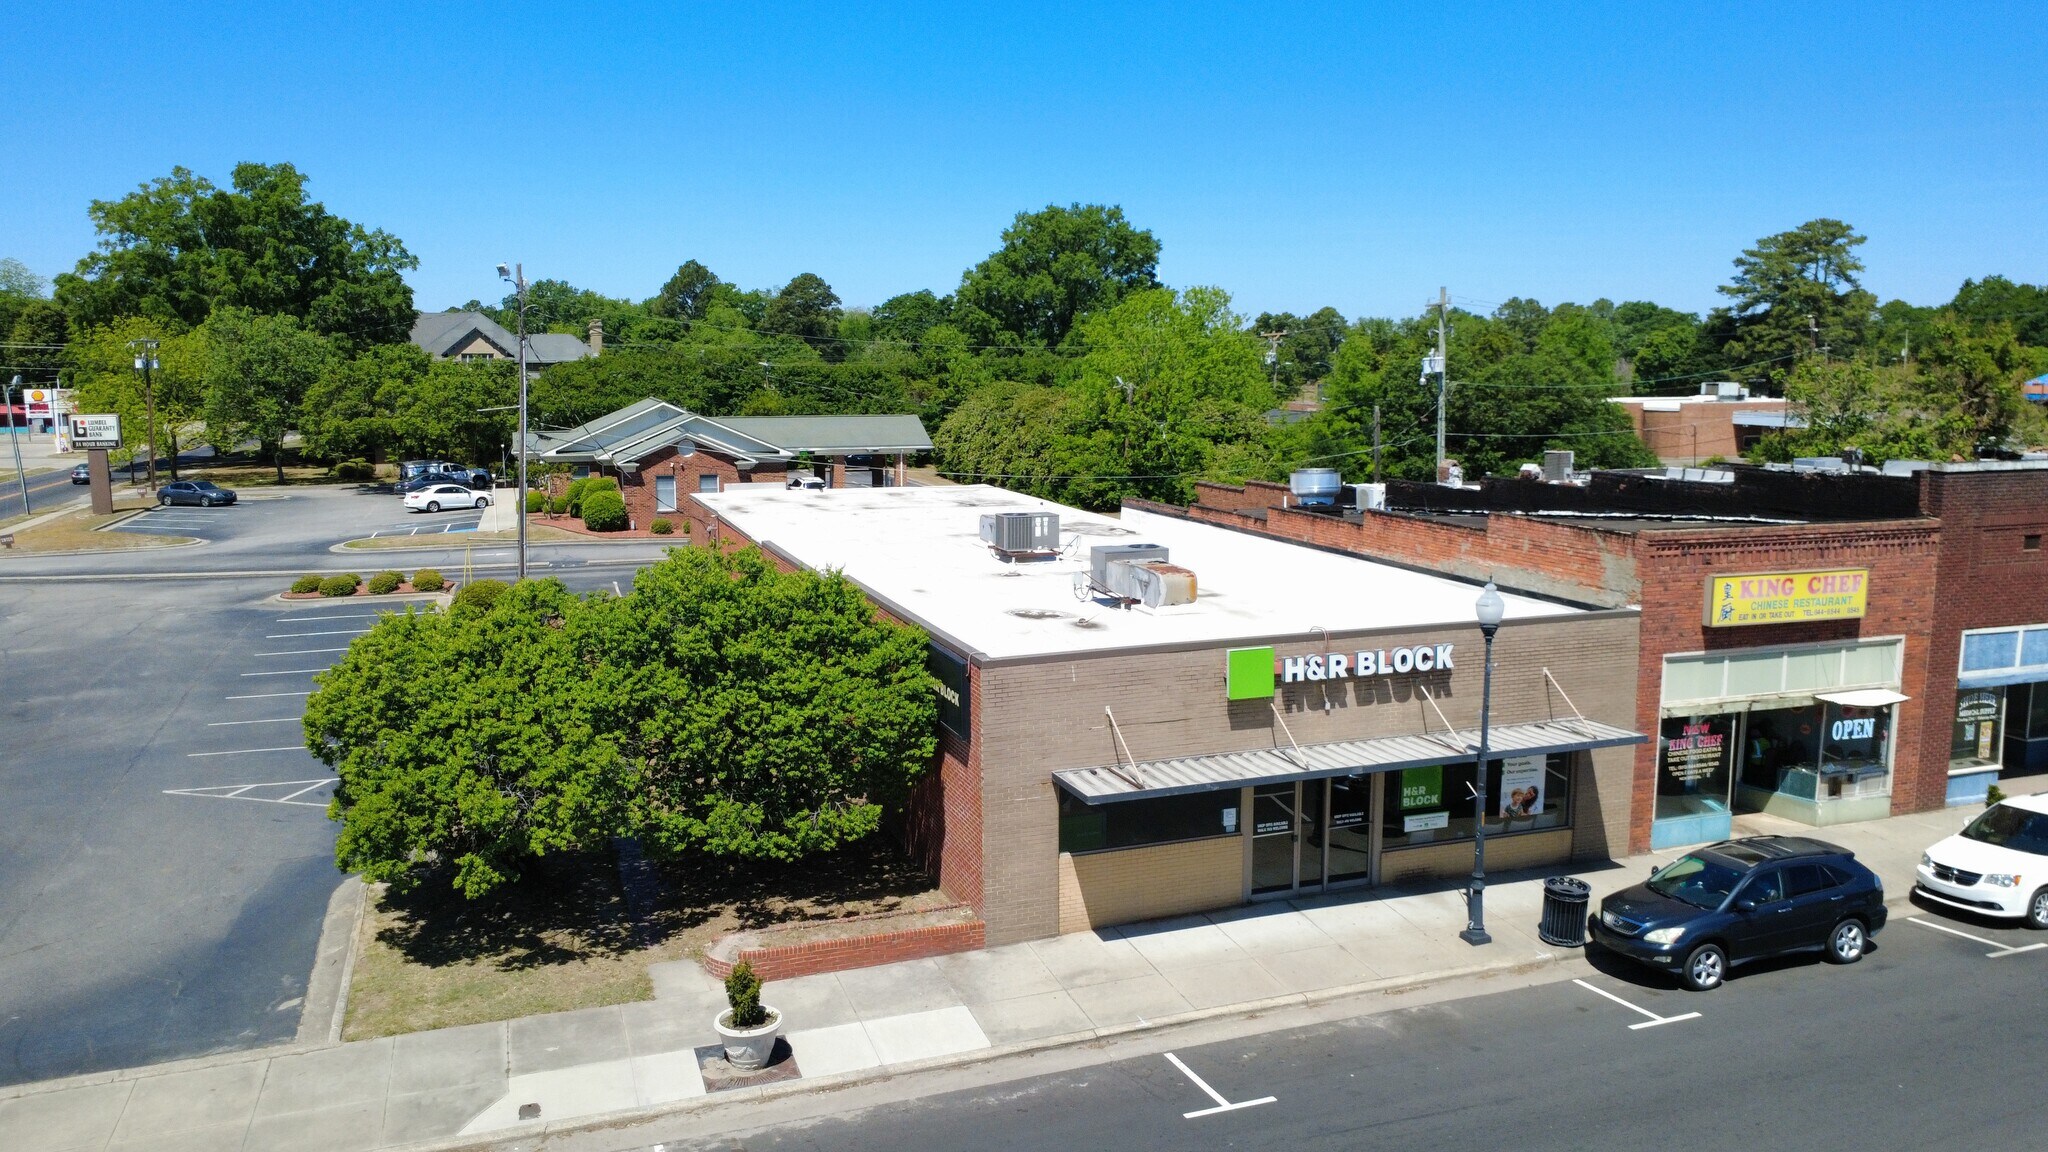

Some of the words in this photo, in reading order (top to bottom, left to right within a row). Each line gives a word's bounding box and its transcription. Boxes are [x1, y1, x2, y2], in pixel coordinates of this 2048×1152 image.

[1739, 577, 1795, 599] KING
[1807, 574, 1864, 595] CHEF
[1750, 599, 1789, 611] CHINESE
[1793, 595, 1854, 607] RESTAURANT
[1738, 613, 1749, 621] EAT
[1759, 612, 1767, 620] OR
[1769, 611, 1783, 619] TAKE
[1282, 653, 1349, 683] H&R
[1355, 643, 1454, 676] BLOCK
[1683, 724, 1710, 735] NEW
[1832, 718, 1875, 741] OPEN
[1669, 738, 1693, 750] KING
[1698, 735, 1723, 747] CHEF
[1403, 785, 1426, 797] H&R
[1403, 795, 1440, 807] BLOCK
